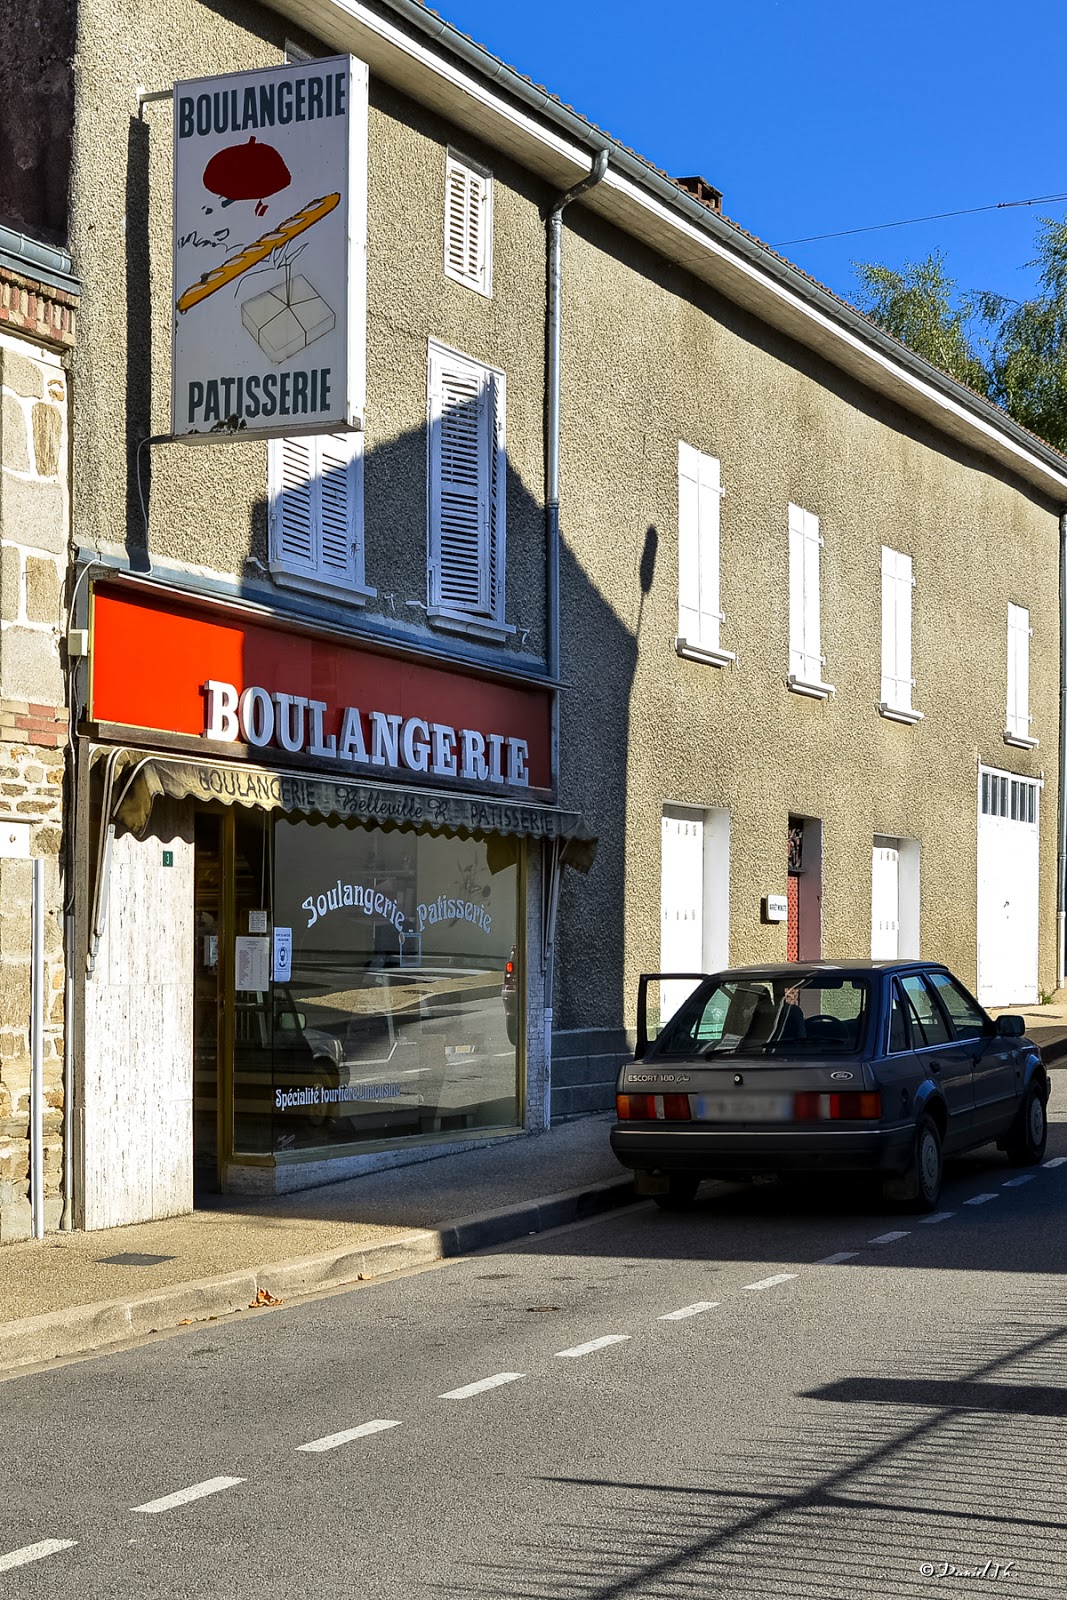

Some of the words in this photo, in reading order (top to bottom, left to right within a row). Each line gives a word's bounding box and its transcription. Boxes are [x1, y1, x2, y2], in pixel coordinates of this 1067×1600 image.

[179, 72, 346, 139] BOULANGERIE
[188, 367, 331, 423] PATISSERIE
[203, 679, 529, 787] BOULANGERIE
[199, 768, 316, 806] BOULANGERIE
[335, 786, 423, 818] Belleville
[470, 802, 554, 832] PATISSERIE
[275, 1085, 320, 1112] Spécialité
[628, 1074, 658, 1082] ESCORT
